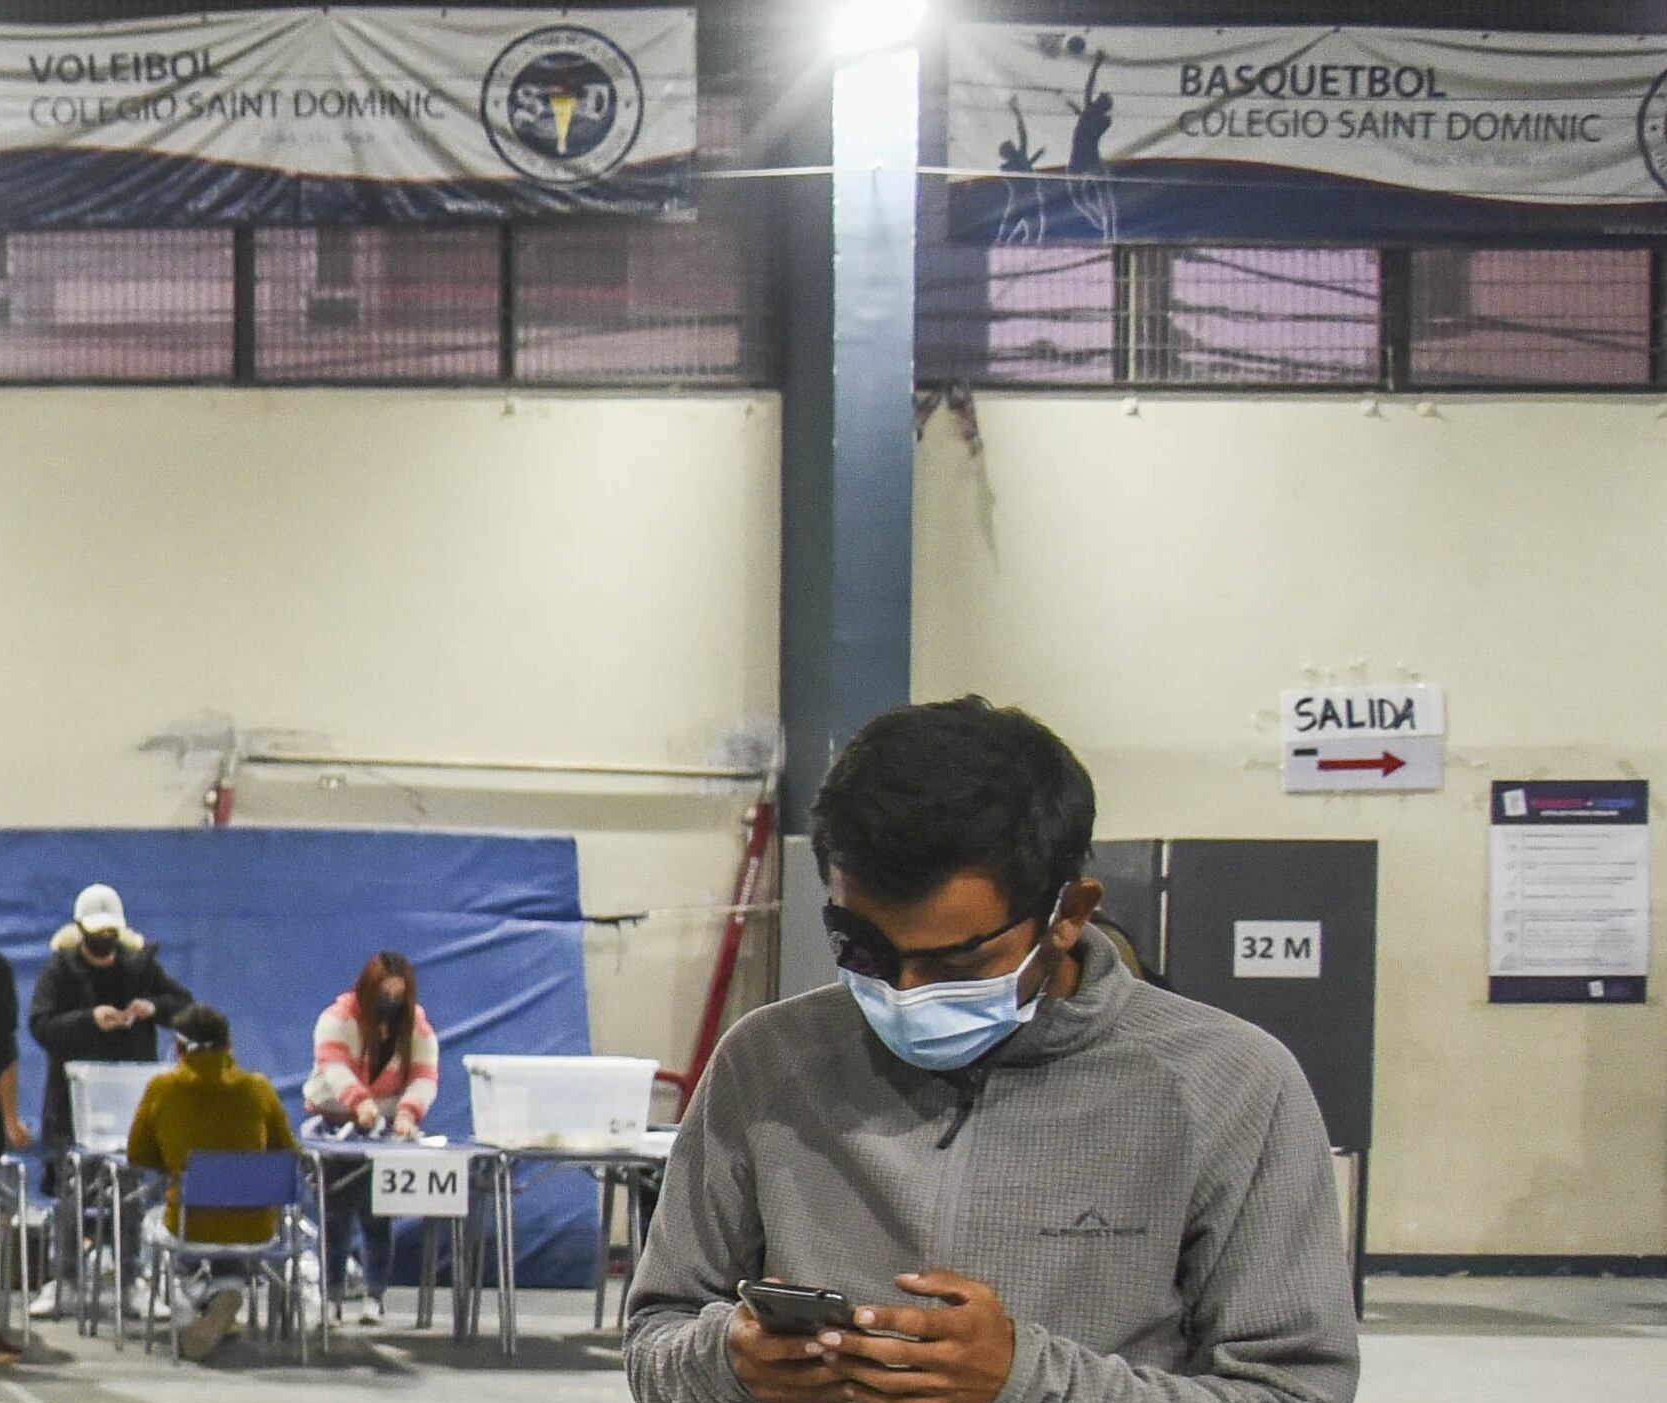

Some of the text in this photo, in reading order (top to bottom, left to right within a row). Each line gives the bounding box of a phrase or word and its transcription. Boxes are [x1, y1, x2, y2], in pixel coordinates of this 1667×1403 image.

[28, 50, 221, 84] VOLEIBOL
[1179, 65, 1448, 99] BASQUETBOL
[29, 86, 447, 129] COLEGIO SAINT DOMINIC
[1179, 109, 1604, 143] COLEGIO SAINT DOMINIC
[1293, 697, 1418, 733] SALIDA
[1240, 936, 1312, 961] 32 M
[381, 1169, 458, 1195] 32 M
